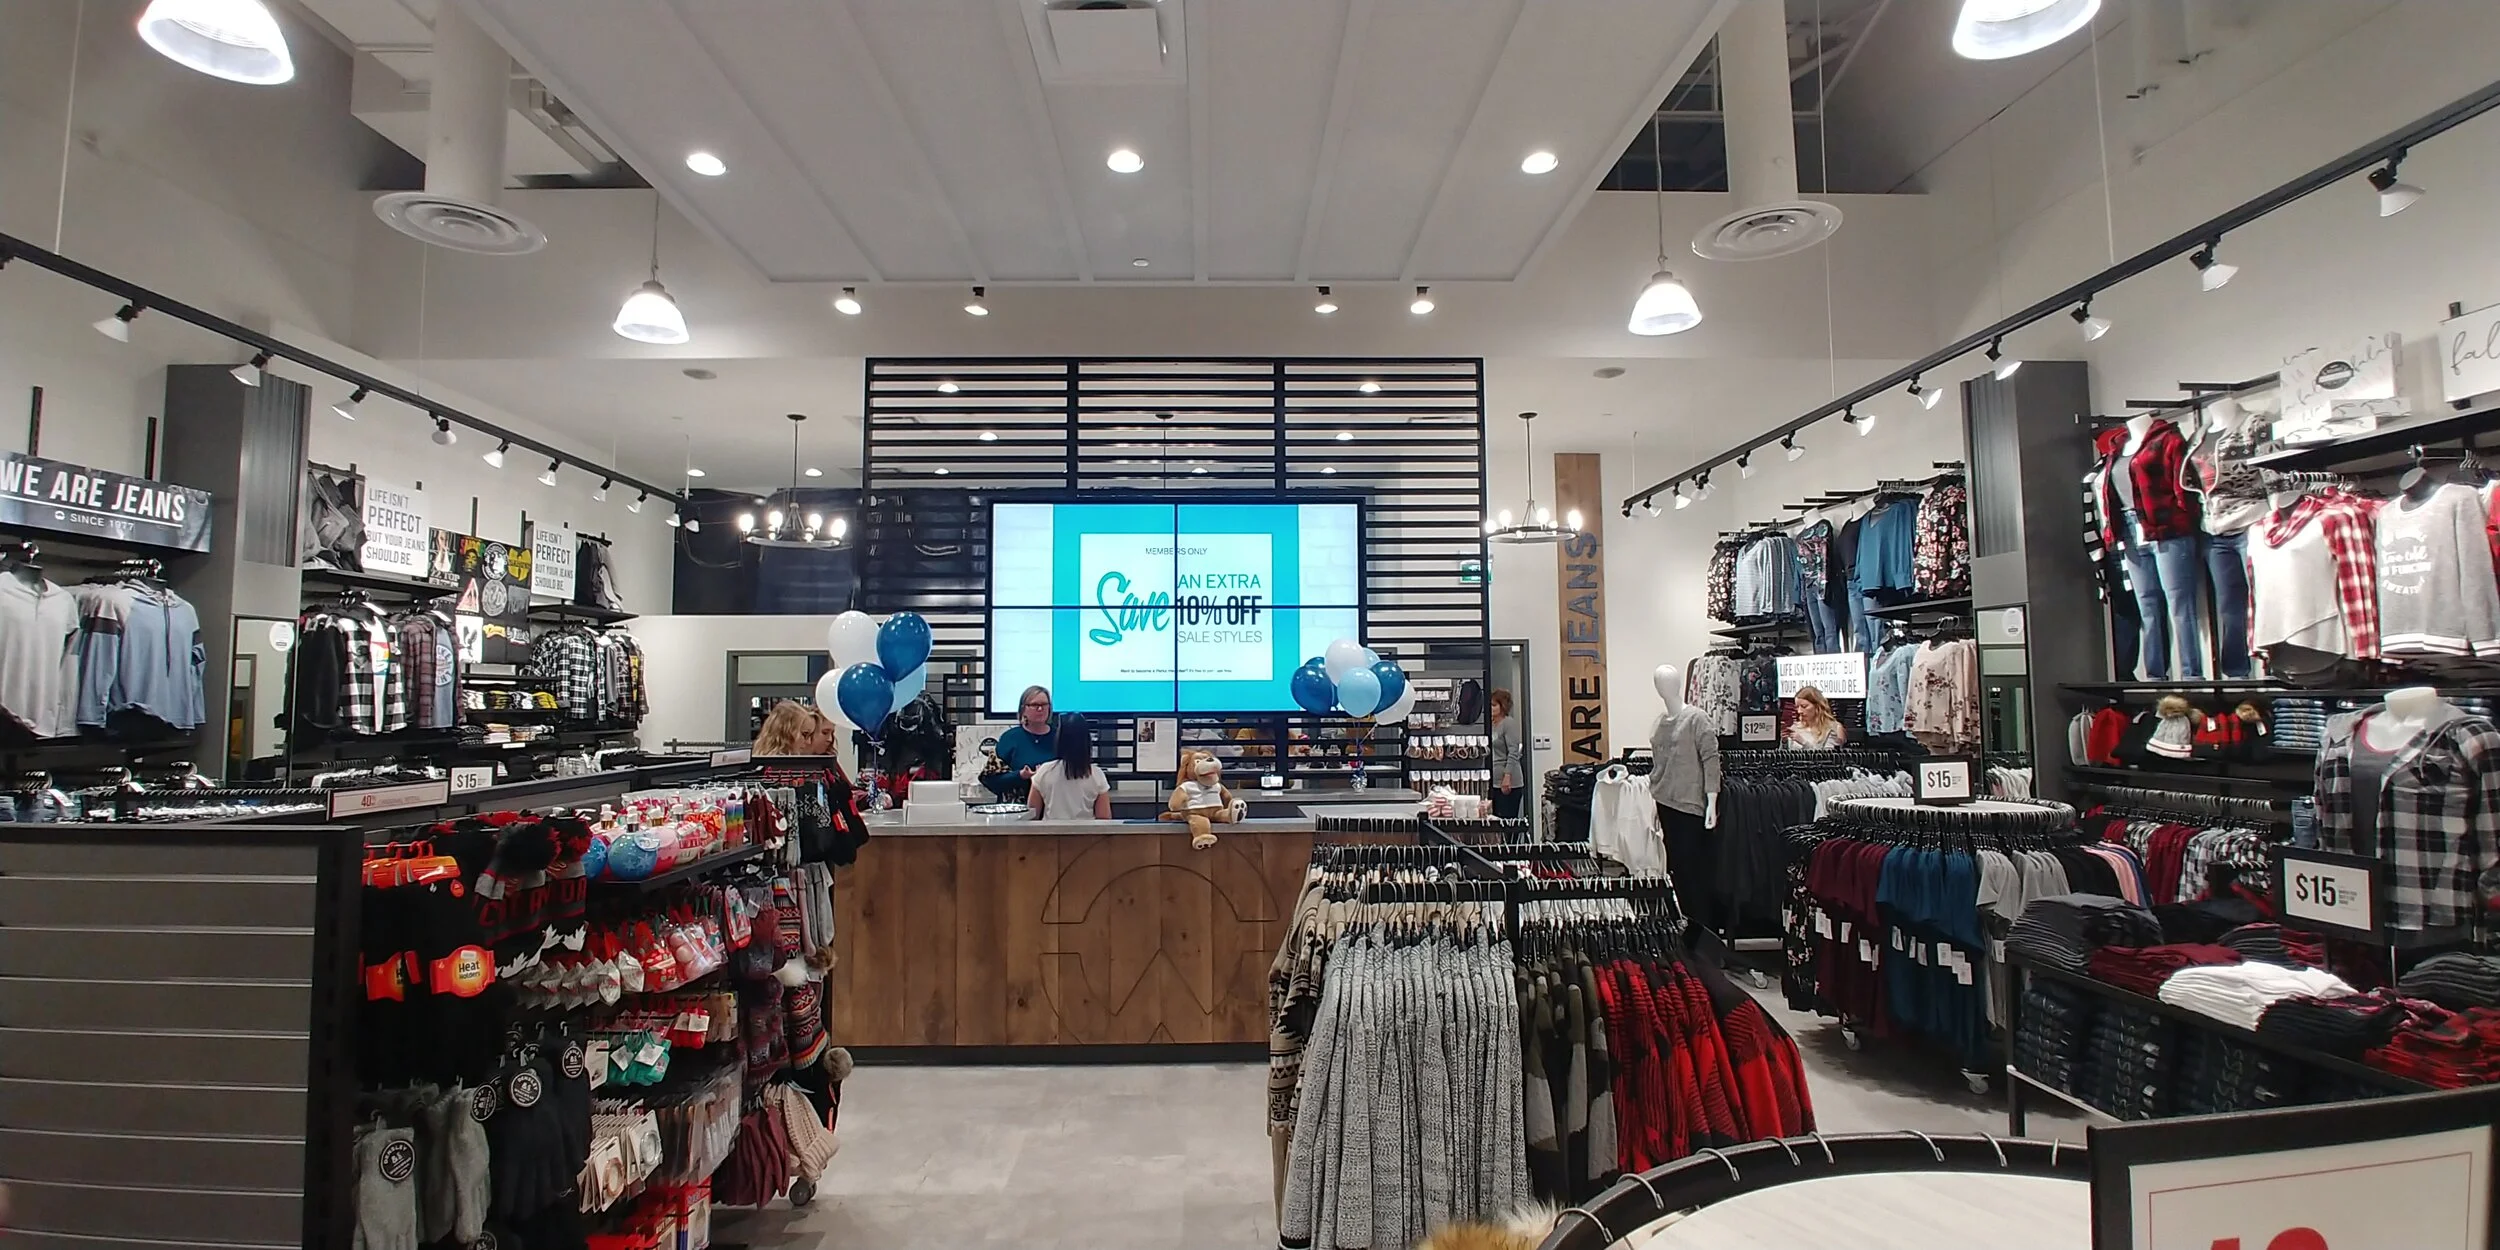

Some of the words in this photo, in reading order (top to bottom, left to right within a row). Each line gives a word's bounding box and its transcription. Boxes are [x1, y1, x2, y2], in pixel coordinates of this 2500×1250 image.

[0, 460, 42, 496] WE
[50, 471, 106, 508] ARE
[111, 483, 186, 521] JEANS
[369, 488, 388, 504] LIFE
[389, 493, 409, 509] ISN'T
[70, 513, 105, 527] SINCE
[368, 506, 422, 534] PERFECT
[367, 531, 382, 543] BUT
[384, 534, 403, 548] YOUR
[404, 539, 426, 552] JEANS
[536, 530, 548, 542] LIFE
[366, 546, 399, 563] SHOULD
[536, 544, 571, 565] PERFECT
[1145, 547, 1187, 556] MEMBERS
[1187, 547, 1208, 556] ONLY
[1177, 574, 1201, 589] AN
[1206, 574, 1262, 589] EXTRA
[1565, 532, 1600, 664] JEANS
[1089, 571, 1171, 646] Save
[1177, 595, 1222, 626] 10%
[1226, 595, 1262, 626] OFF
[1178, 630, 1210, 643] SALE
[1213, 630, 1262, 643] STYLES
[1780, 663, 1793, 677] LIFE
[1812, 661, 1841, 675] PERFECT
[1844, 660, 1858, 674] BUT
[1781, 680, 1797, 693] YOUR
[1820, 680, 1846, 693] SHOULD
[1569, 676, 1602, 760] ARE
[456, 774, 477, 788] $15
[1927, 770, 1951, 788] $15
[2296, 873, 2337, 907] $15
[458, 961, 480, 973] Heat
